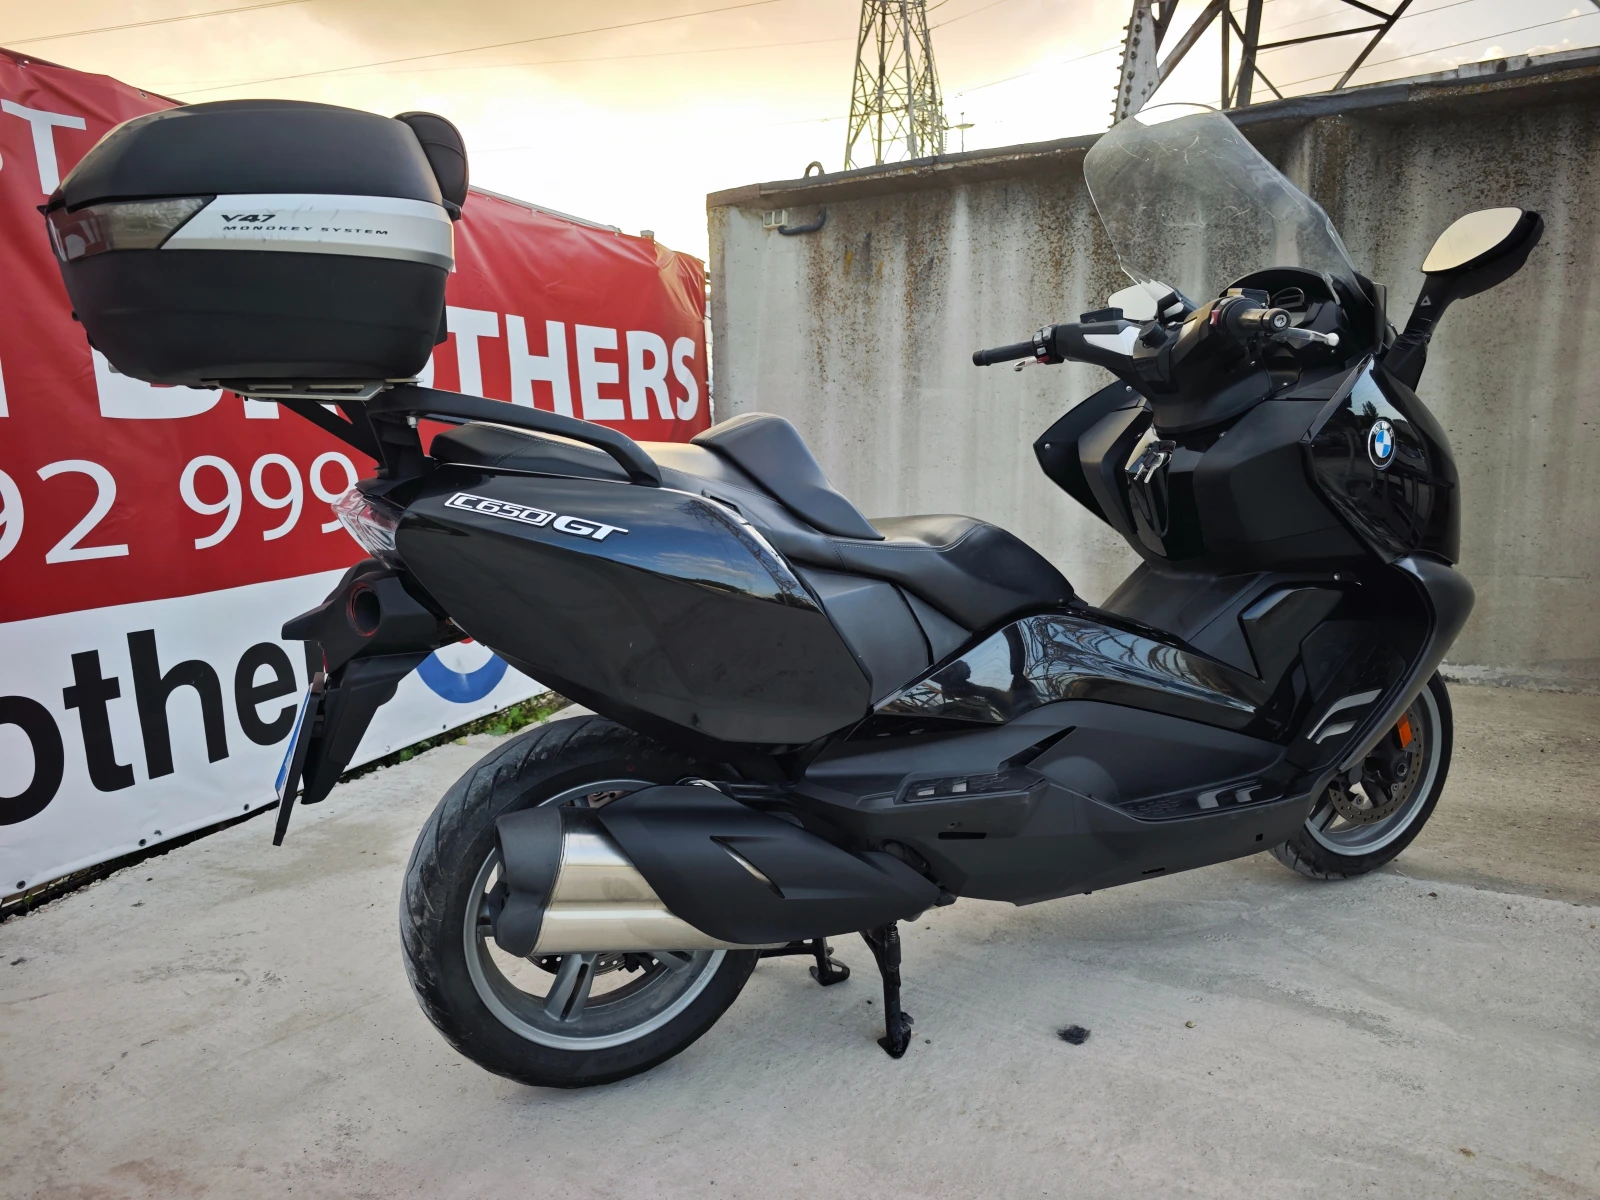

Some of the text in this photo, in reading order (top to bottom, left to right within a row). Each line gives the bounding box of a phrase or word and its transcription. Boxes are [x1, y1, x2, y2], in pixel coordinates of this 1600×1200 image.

[0, 98, 87, 196] T
[221, 214, 276, 223] V47
[321, 227, 389, 235] SYSTEM
[0, 628, 313, 827] othe
